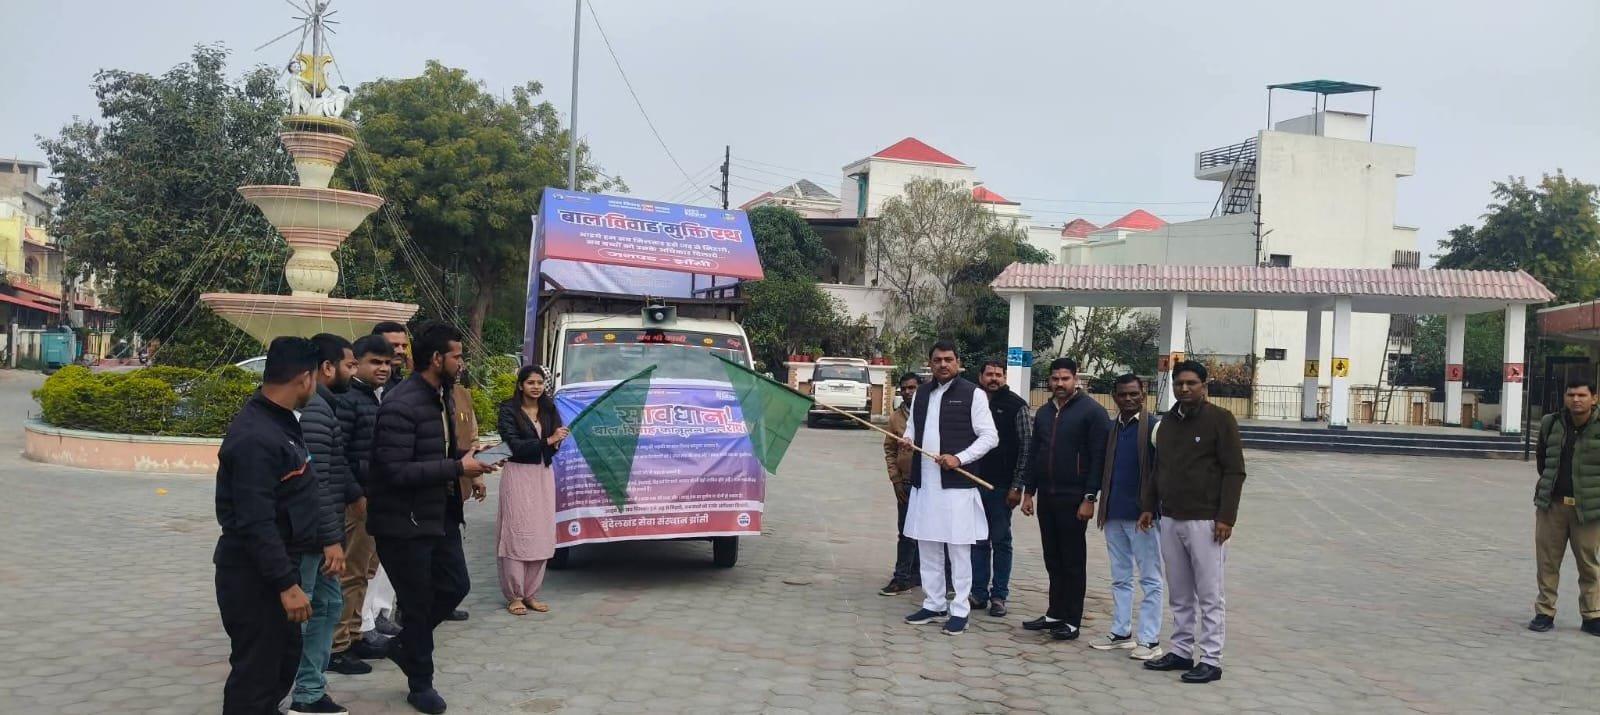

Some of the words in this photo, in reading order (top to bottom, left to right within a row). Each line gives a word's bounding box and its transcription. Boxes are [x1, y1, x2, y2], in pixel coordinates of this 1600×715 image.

[557, 208, 602, 227] बाल
[604, 212, 659, 233] विवाह
[660, 221, 708, 240] मुक्ति
[709, 227, 743, 242] रथ
[613, 404, 733, 426] सावधान!
[638, 516, 655, 526] सेवा
[657, 515, 687, 525] संस्थान
